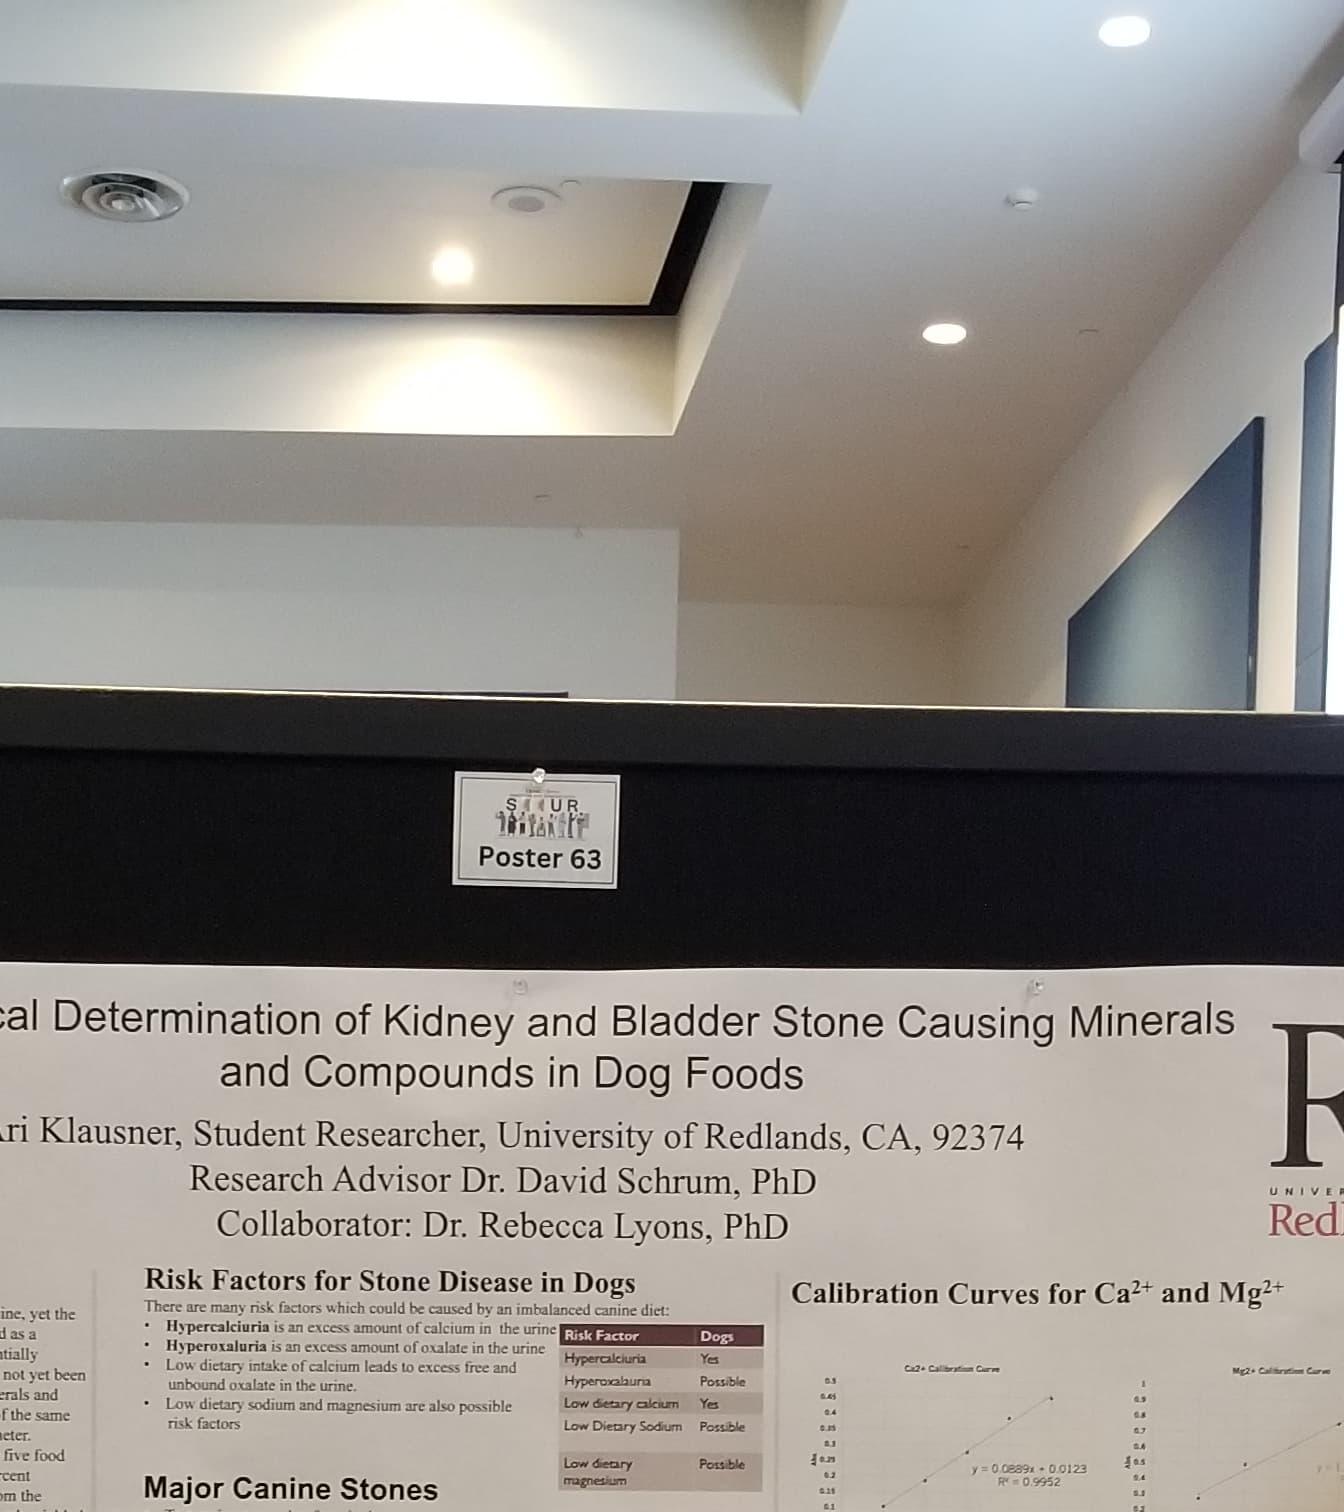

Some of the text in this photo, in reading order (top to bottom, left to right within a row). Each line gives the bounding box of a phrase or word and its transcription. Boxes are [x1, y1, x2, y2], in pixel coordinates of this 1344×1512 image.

[478, 845, 602, 870] Poster 63
[54, 999, 320, 1036] Determination
[335, 1002, 373, 1036] of
[384, 1003, 515, 1046] Kidney
[527, 1005, 596, 1038] and
[612, 1003, 761, 1037] Bladder
[772, 1004, 884, 1038] Stone
[898, 1004, 1054, 1048] Causing
[1071, 1001, 1235, 1038] Minerals
[220, 1054, 804, 1098] and Compounds in Dog Foods
[39, 1116, 182, 1151] Klausner,
[194, 1119, 307, 1148] Student
[315, 1119, 486, 1154] Researcher,
[497, 1120, 654, 1157] University
[664, 1121, 699, 1150] of
[704, 1121, 851, 1155] Redlands,
[862, 1123, 921, 1156] CA,
[932, 1123, 1025, 1151] 92374
[190, 1164, 817, 1200] Research Advisor Dr. David Schrum, PhD
[217, 1209, 789, 1247] Collaborator: Dr. Rebecca Lyons, PhD
[146, 1267, 636, 1300] Risk Factors for Stone Disease in Dogs
[791, 1281, 939, 1305] Calibration
[948, 1282, 1040, 1305] Curves
[1048, 1282, 1087, 1305] for
[1161, 1281, 1210, 1304] and
[28, 1309, 51, 1324] yet
[54, 1307, 76, 1321] the
[564, 1329, 640, 1342] Risk Factor
[700, 1330, 735, 1345] Dogs
[564, 1351, 647, 1367] Hypercalciuria
[699, 1352, 720, 1365] Yes
[700, 1375, 746, 1388] Possible
[563, 1397, 680, 1413] Low dietary calcium
[699, 1397, 720, 1410] Yes
[563, 1419, 683, 1435] Low Dietary Sodium
[699, 1421, 746, 1433] Possible
[563, 1457, 633, 1473] Low dietary
[699, 1458, 746, 1471] Possible
[144, 1475, 438, 1505] Major Canine Stones
[563, 1476, 628, 1489] magnesium
